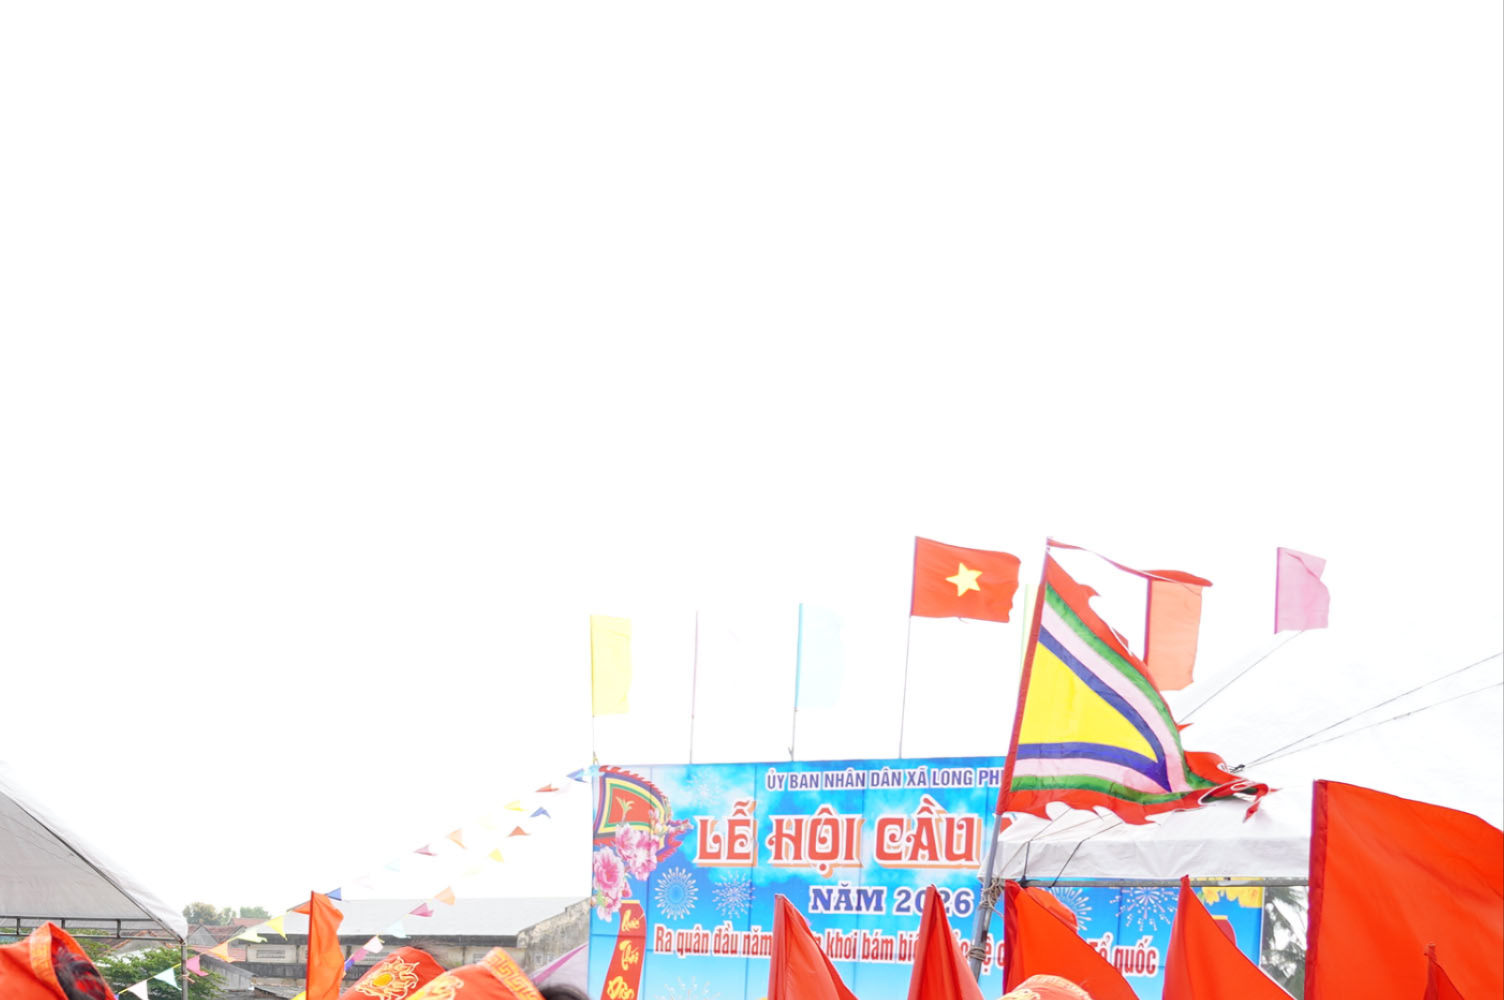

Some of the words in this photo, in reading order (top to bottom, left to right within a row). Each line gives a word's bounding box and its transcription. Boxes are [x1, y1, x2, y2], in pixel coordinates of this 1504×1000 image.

[767, 769, 785, 790] ỦY
[789, 773, 820, 789] BAN
[824, 768, 866, 788] NHÂN
[871, 768, 903, 787] DÂN
[907, 767, 928, 786] XÃ
[932, 769, 974, 786] LONG
[696, 800, 754, 862] LỄ
[766, 806, 859, 874] HỘI
[874, 797, 976, 863] CẦU
[811, 882, 884, 911] NĂM
[655, 926, 672, 952] Ra
[676, 926, 709, 956] quân
[713, 922, 739, 955] đầu
[743, 928, 774, 956] năm
[862, 931, 894, 961] bám
[1113, 938, 1157, 975] quốc
